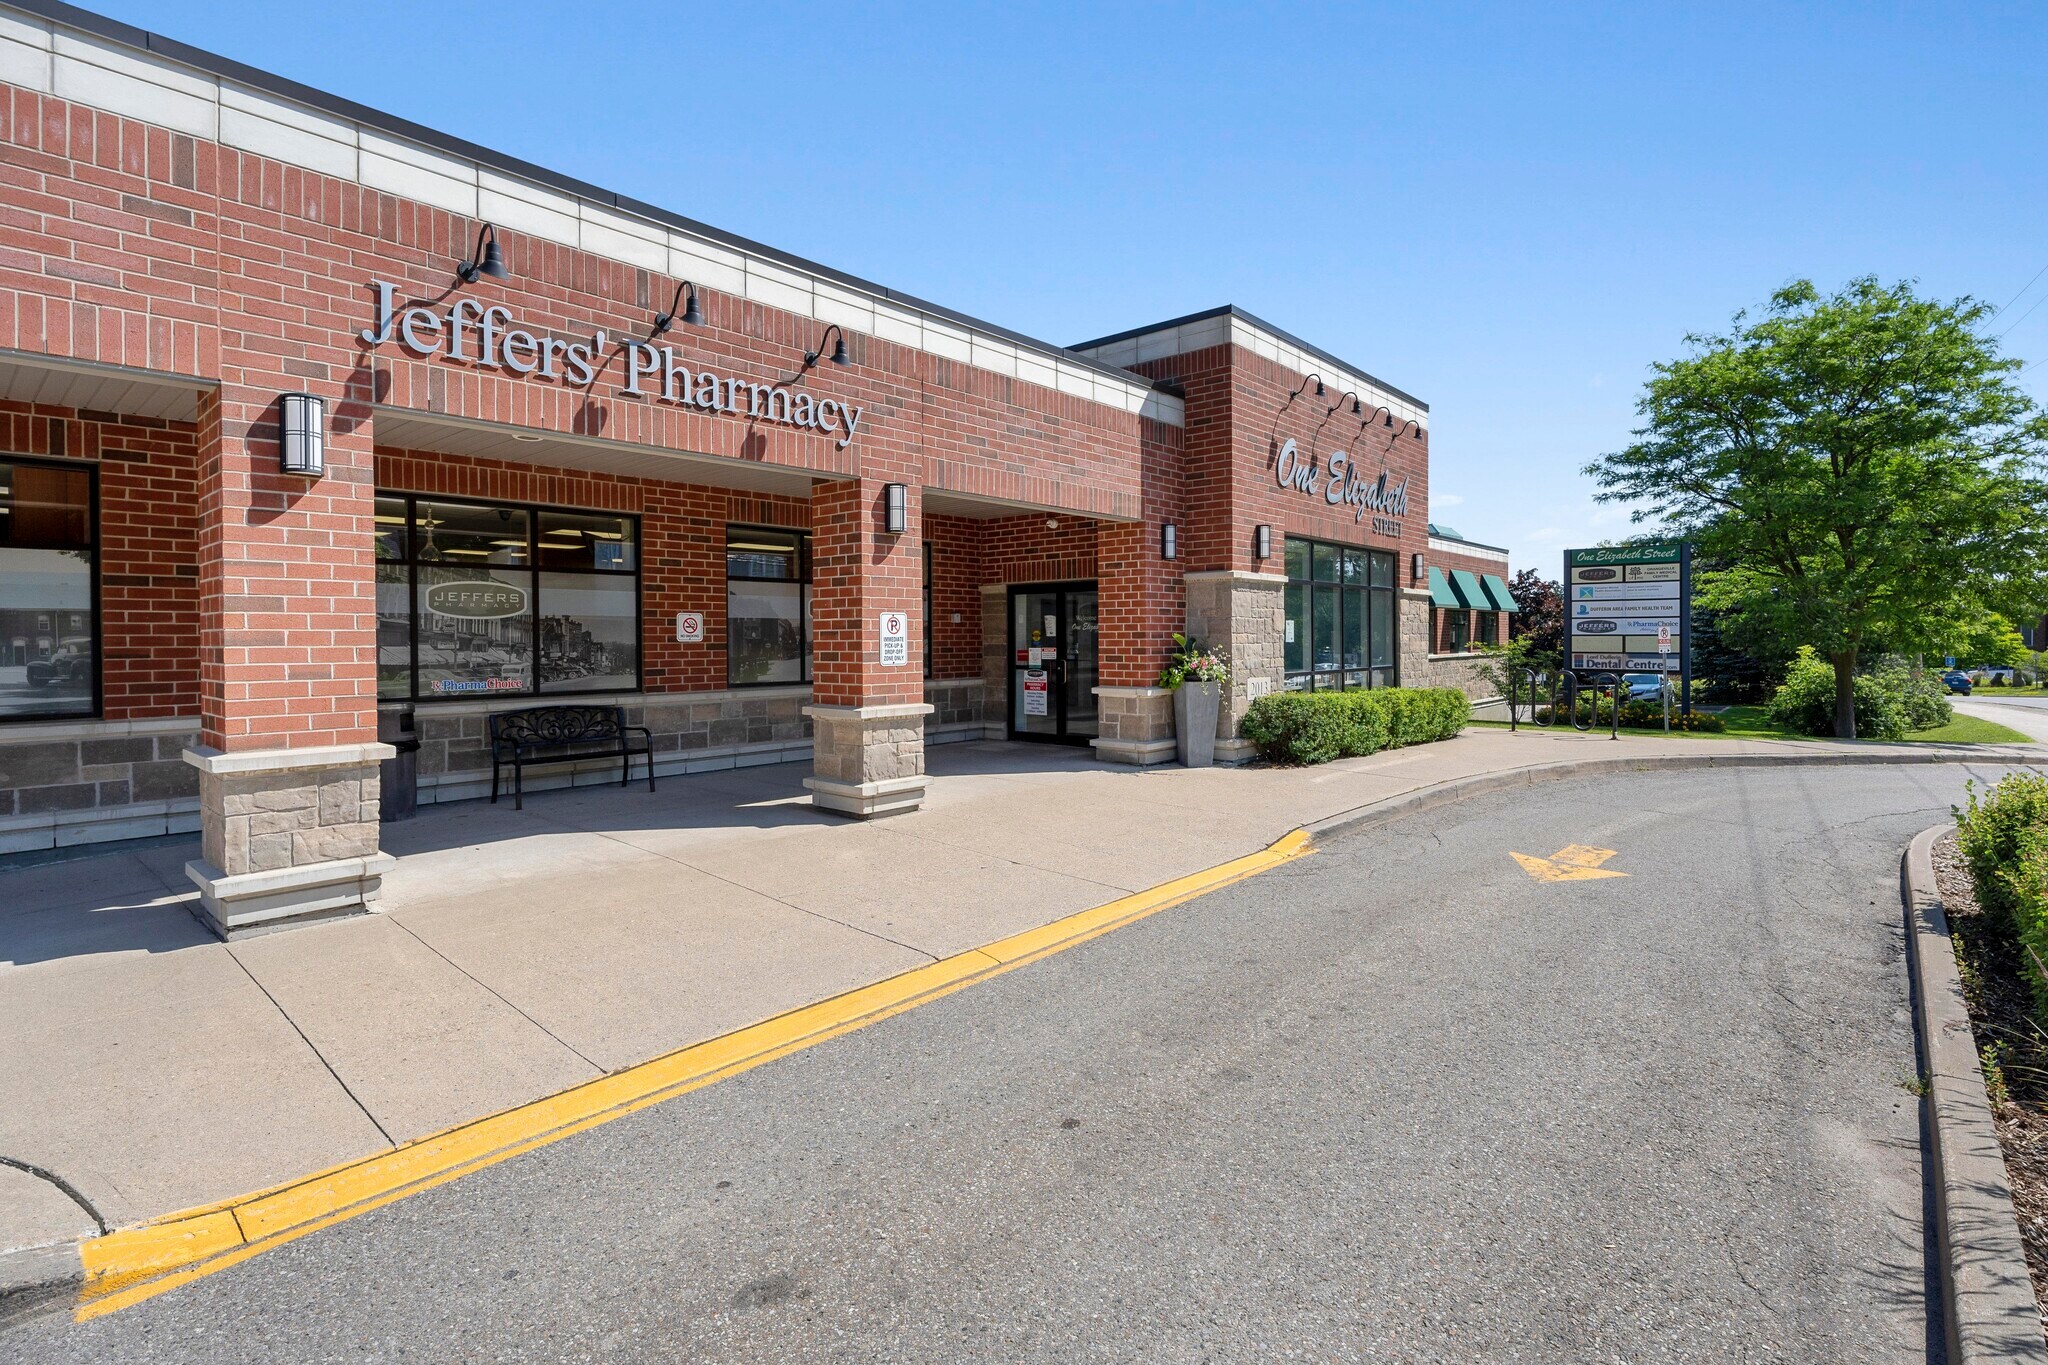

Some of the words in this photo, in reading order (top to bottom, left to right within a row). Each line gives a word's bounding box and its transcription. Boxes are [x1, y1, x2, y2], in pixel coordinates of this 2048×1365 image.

[361, 278, 605, 385] Jeffers'
[622, 337, 864, 448] Pharmacy
[1277, 437, 1319, 496] One
[1325, 449, 1410, 525] Elizabeth
[1372, 515, 1403, 539] STREET
[1577, 552, 1595, 562] One
[1596, 549, 1642, 562] Elizabeth
[1643, 549, 1676, 559] Street
[434, 592, 519, 603] JEFFERS
[1586, 660, 1621, 669] Dental
[1625, 660, 1664, 670] Centre
[442, 677, 523, 691] PharmaChoice
[1251, 681, 1268, 695] 2013
